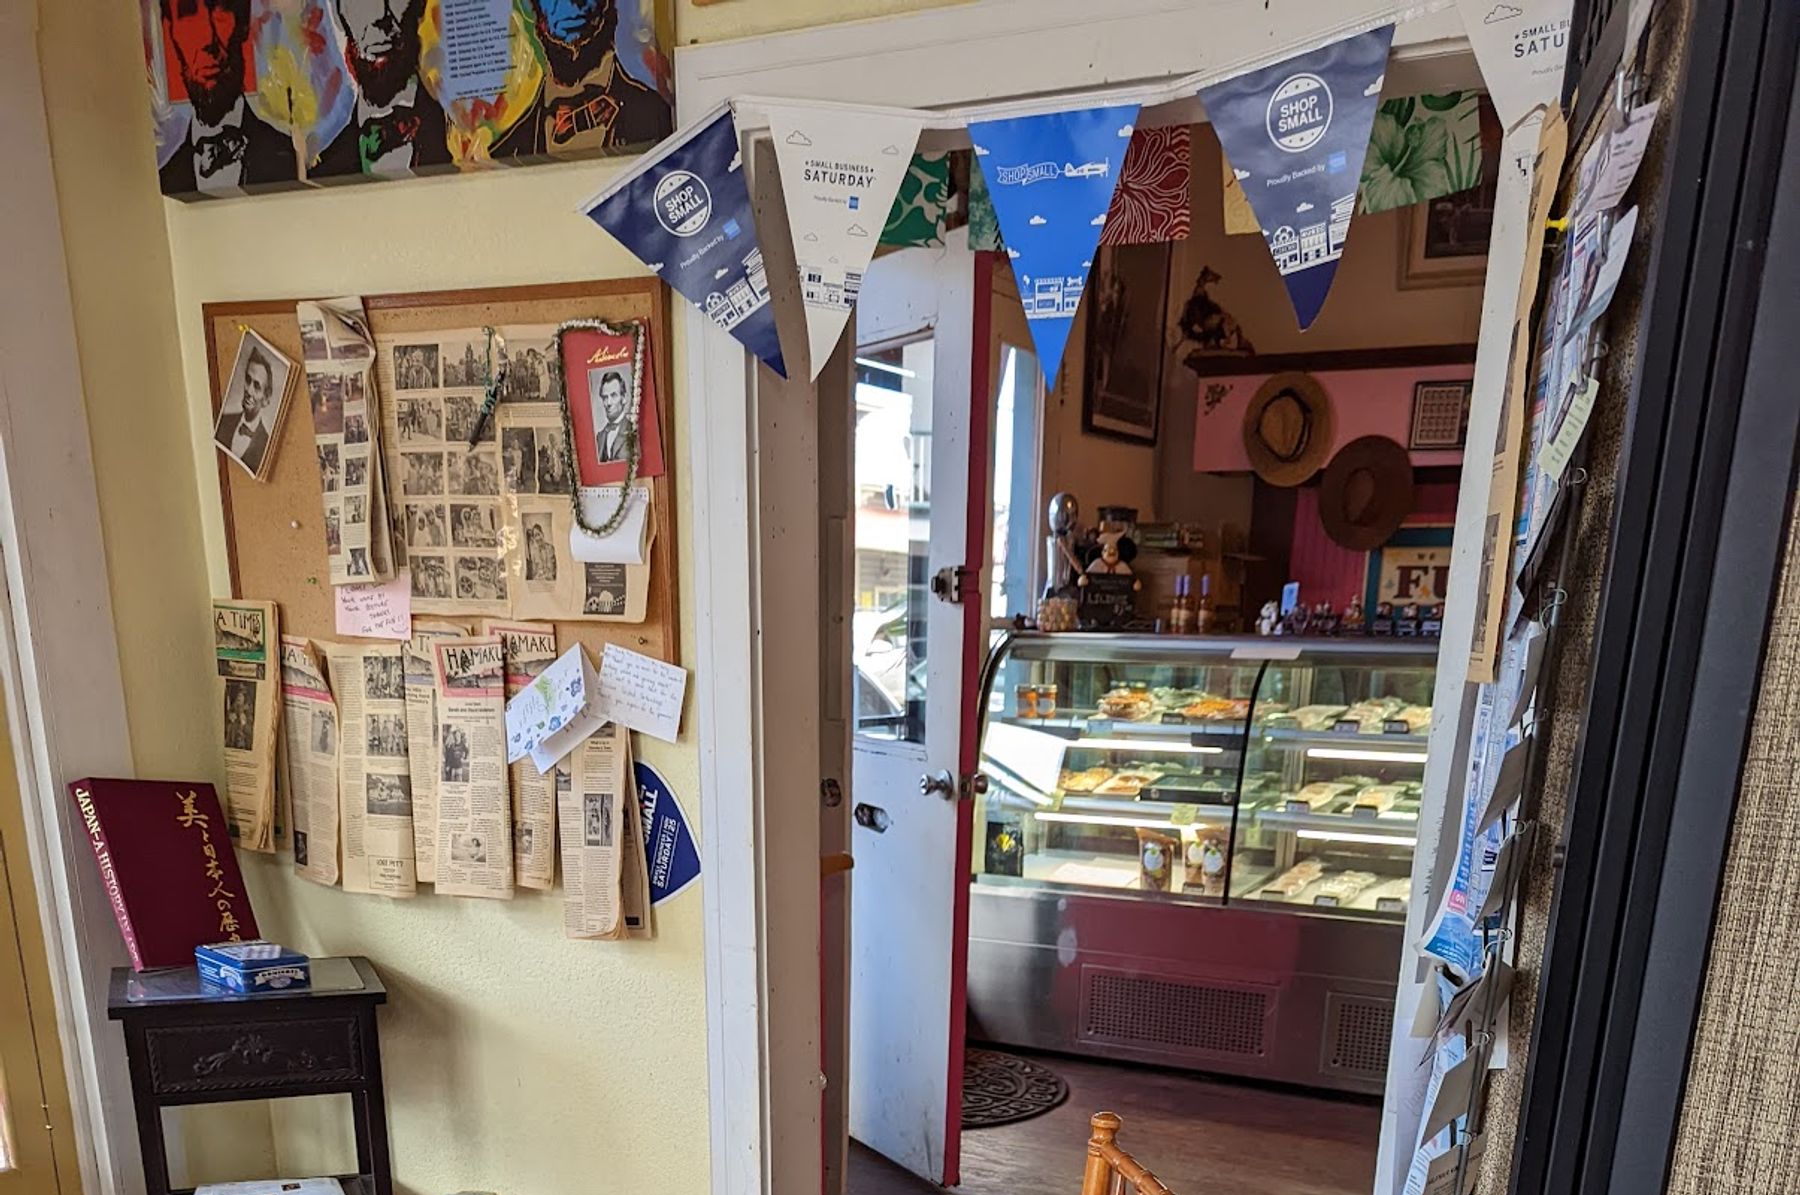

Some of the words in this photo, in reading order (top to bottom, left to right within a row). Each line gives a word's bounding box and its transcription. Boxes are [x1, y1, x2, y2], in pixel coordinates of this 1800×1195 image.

[1521, 23, 1557, 39] SMALL
[1514, 32, 1564, 58] SATU
[1280, 95, 1318, 118] SHOP
[1278, 108, 1323, 132] SMALL
[803, 168, 874, 188] SATURDAY
[810, 160, 833, 169] SMALL
[835, 162, 869, 173] BUSINESS
[1002, 167, 1026, 182] SHOP
[1027, 165, 1055, 180] SMALL
[665, 185, 694, 212] SHOP
[668, 194, 704, 224] SMALL
[231, 611, 261, 632] TIMES
[657, 832, 674, 888] SATURDAY
[97, 851, 125, 913] HISTORY
